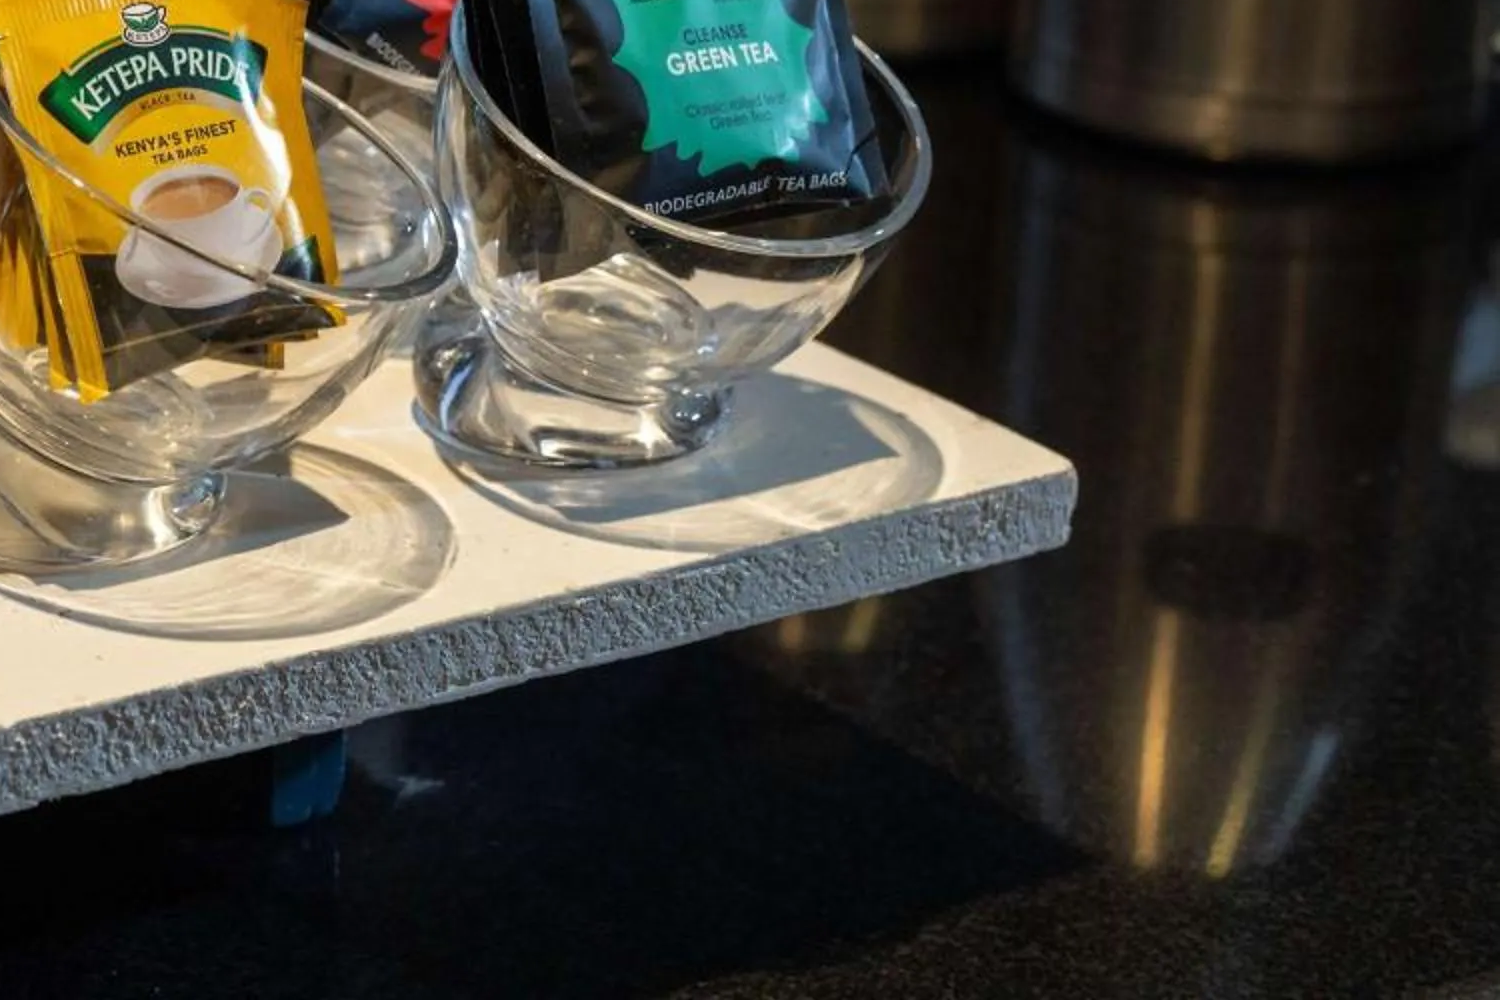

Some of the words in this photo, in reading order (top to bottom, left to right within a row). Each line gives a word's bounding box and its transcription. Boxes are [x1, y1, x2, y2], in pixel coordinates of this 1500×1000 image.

[683, 23, 748, 46] CLEANSE
[666, 46, 738, 76] GREEN
[739, 41, 779, 65] TEA
[70, 50, 170, 122] KETEPA
[170, 46, 250, 90] PRIDE
[114, 130, 183, 159] KENYA'S
[183, 119, 237, 143] FINEST
[151, 151, 176, 166] TEA
[176, 143, 209, 160] BAGS
[644, 175, 771, 216] BIODEGRADABLE
[777, 175, 805, 192] TEA
[809, 170, 848, 189] BAGS
